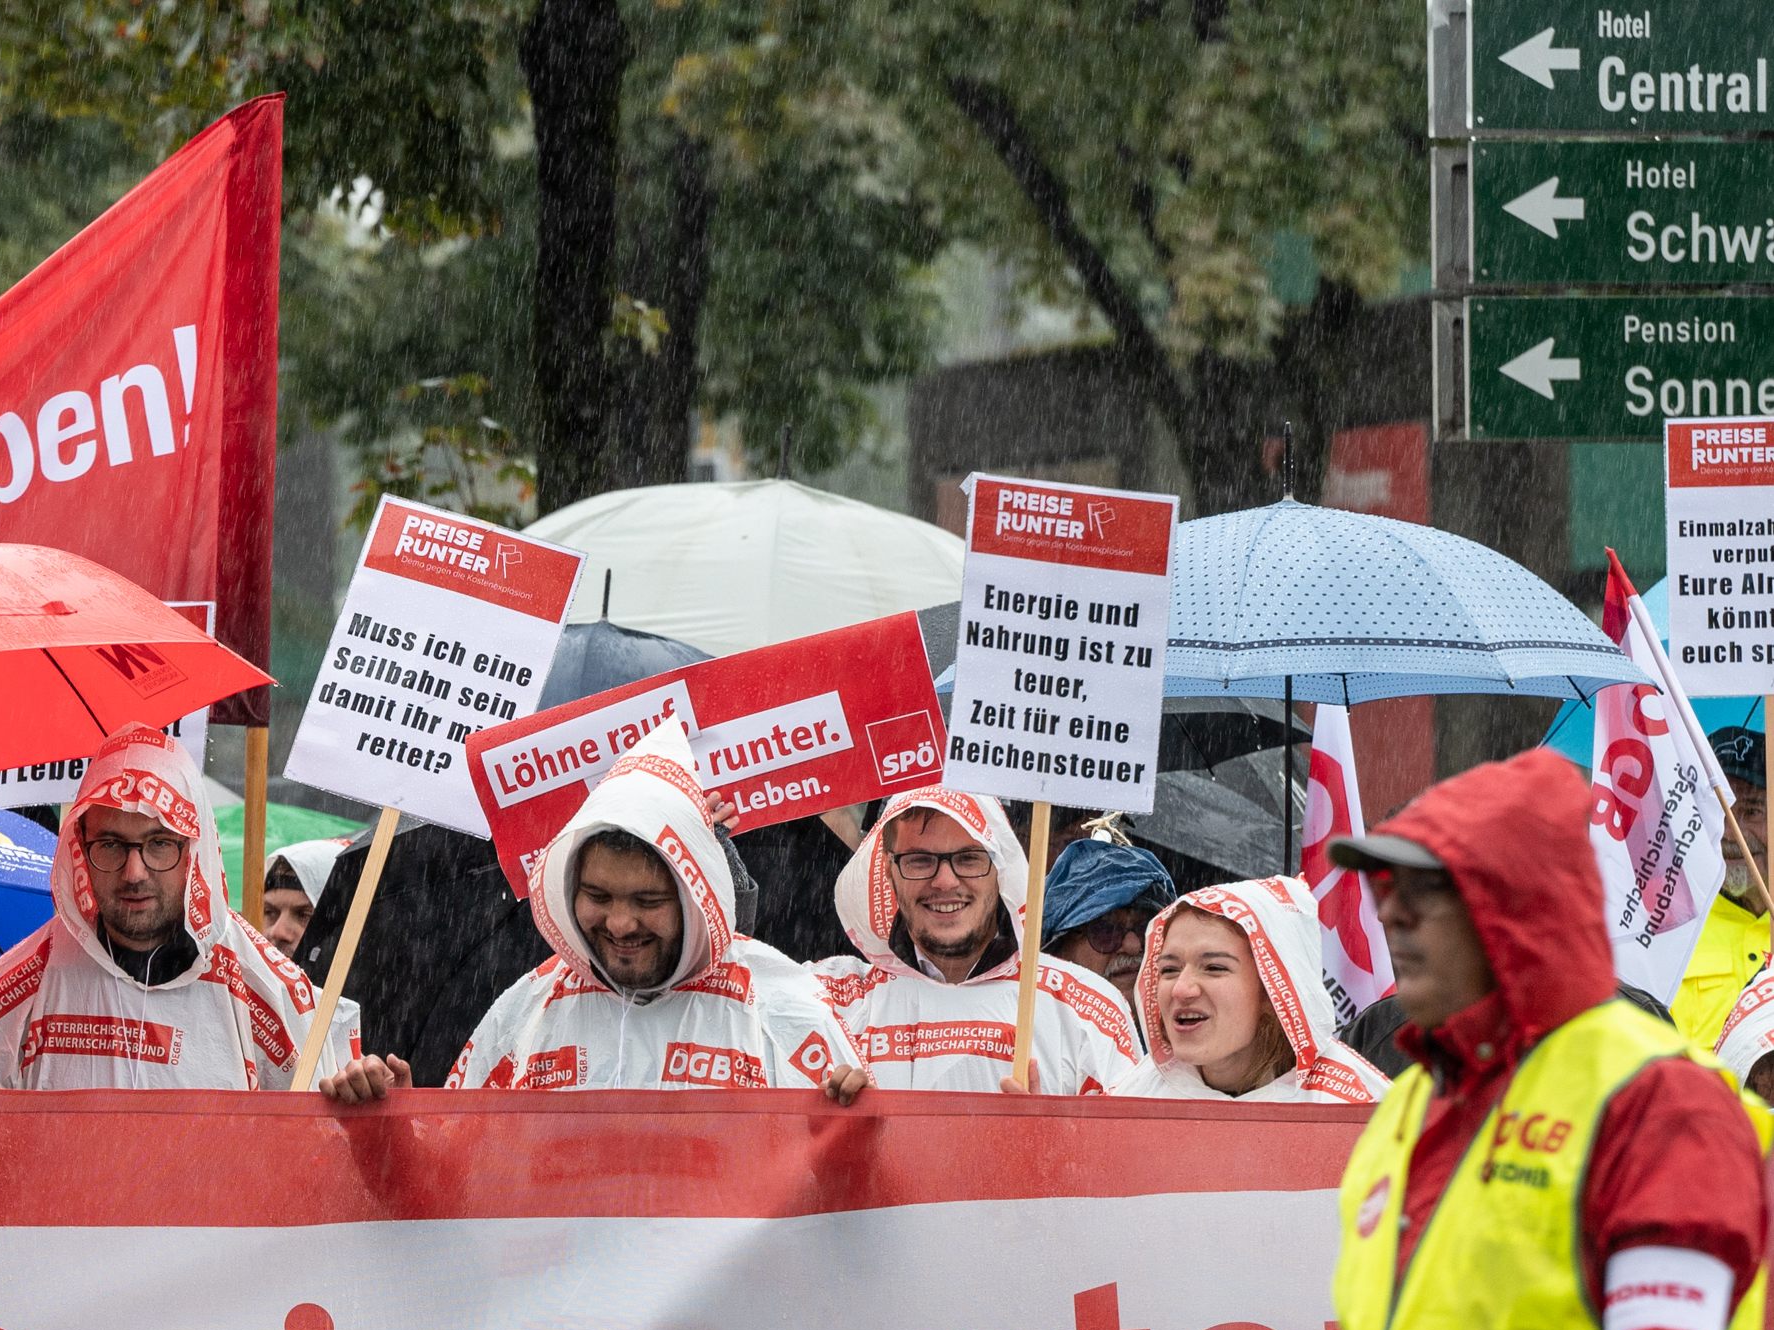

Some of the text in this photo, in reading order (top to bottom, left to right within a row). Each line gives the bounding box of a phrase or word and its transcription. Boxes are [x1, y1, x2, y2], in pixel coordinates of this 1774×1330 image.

[1598, 10, 1650, 38] Hotel
[1598, 55, 1767, 113] Central
[1627, 160, 1695, 188] Hotel
[1624, 315, 1736, 343] Pension
[1691, 427, 1766, 449] PREISE
[998, 489, 1073, 516] PREISE
[402, 514, 485, 551] PREISE
[996, 511, 1085, 540] RUNTER
[395, 534, 491, 575] RUNTER
[401, 555, 533, 601] Demo gegen die Kostenexplosion!
[1679, 574, 1733, 596] Eure
[984, 584, 1140, 628] Energie und
[347, 612, 533, 687] Muss ich eine
[966, 620, 1153, 669] Nahrung ist zu
[1682, 641, 1742, 663] euch
[333, 646, 452, 700] Seilbahn
[1014, 667, 1086, 703] teuer,
[318, 681, 396, 722] damit
[401, 703, 442, 735] ihr
[970, 699, 1130, 743] Zeit für eine
[356, 731, 452, 774] rettet?
[493, 738, 602, 796] Löhne
[709, 720, 841, 777] runter.
[883, 741, 935, 777] SPÖ
[949, 736, 1146, 784] Reichensteuer
[735, 773, 831, 816] Leben.
